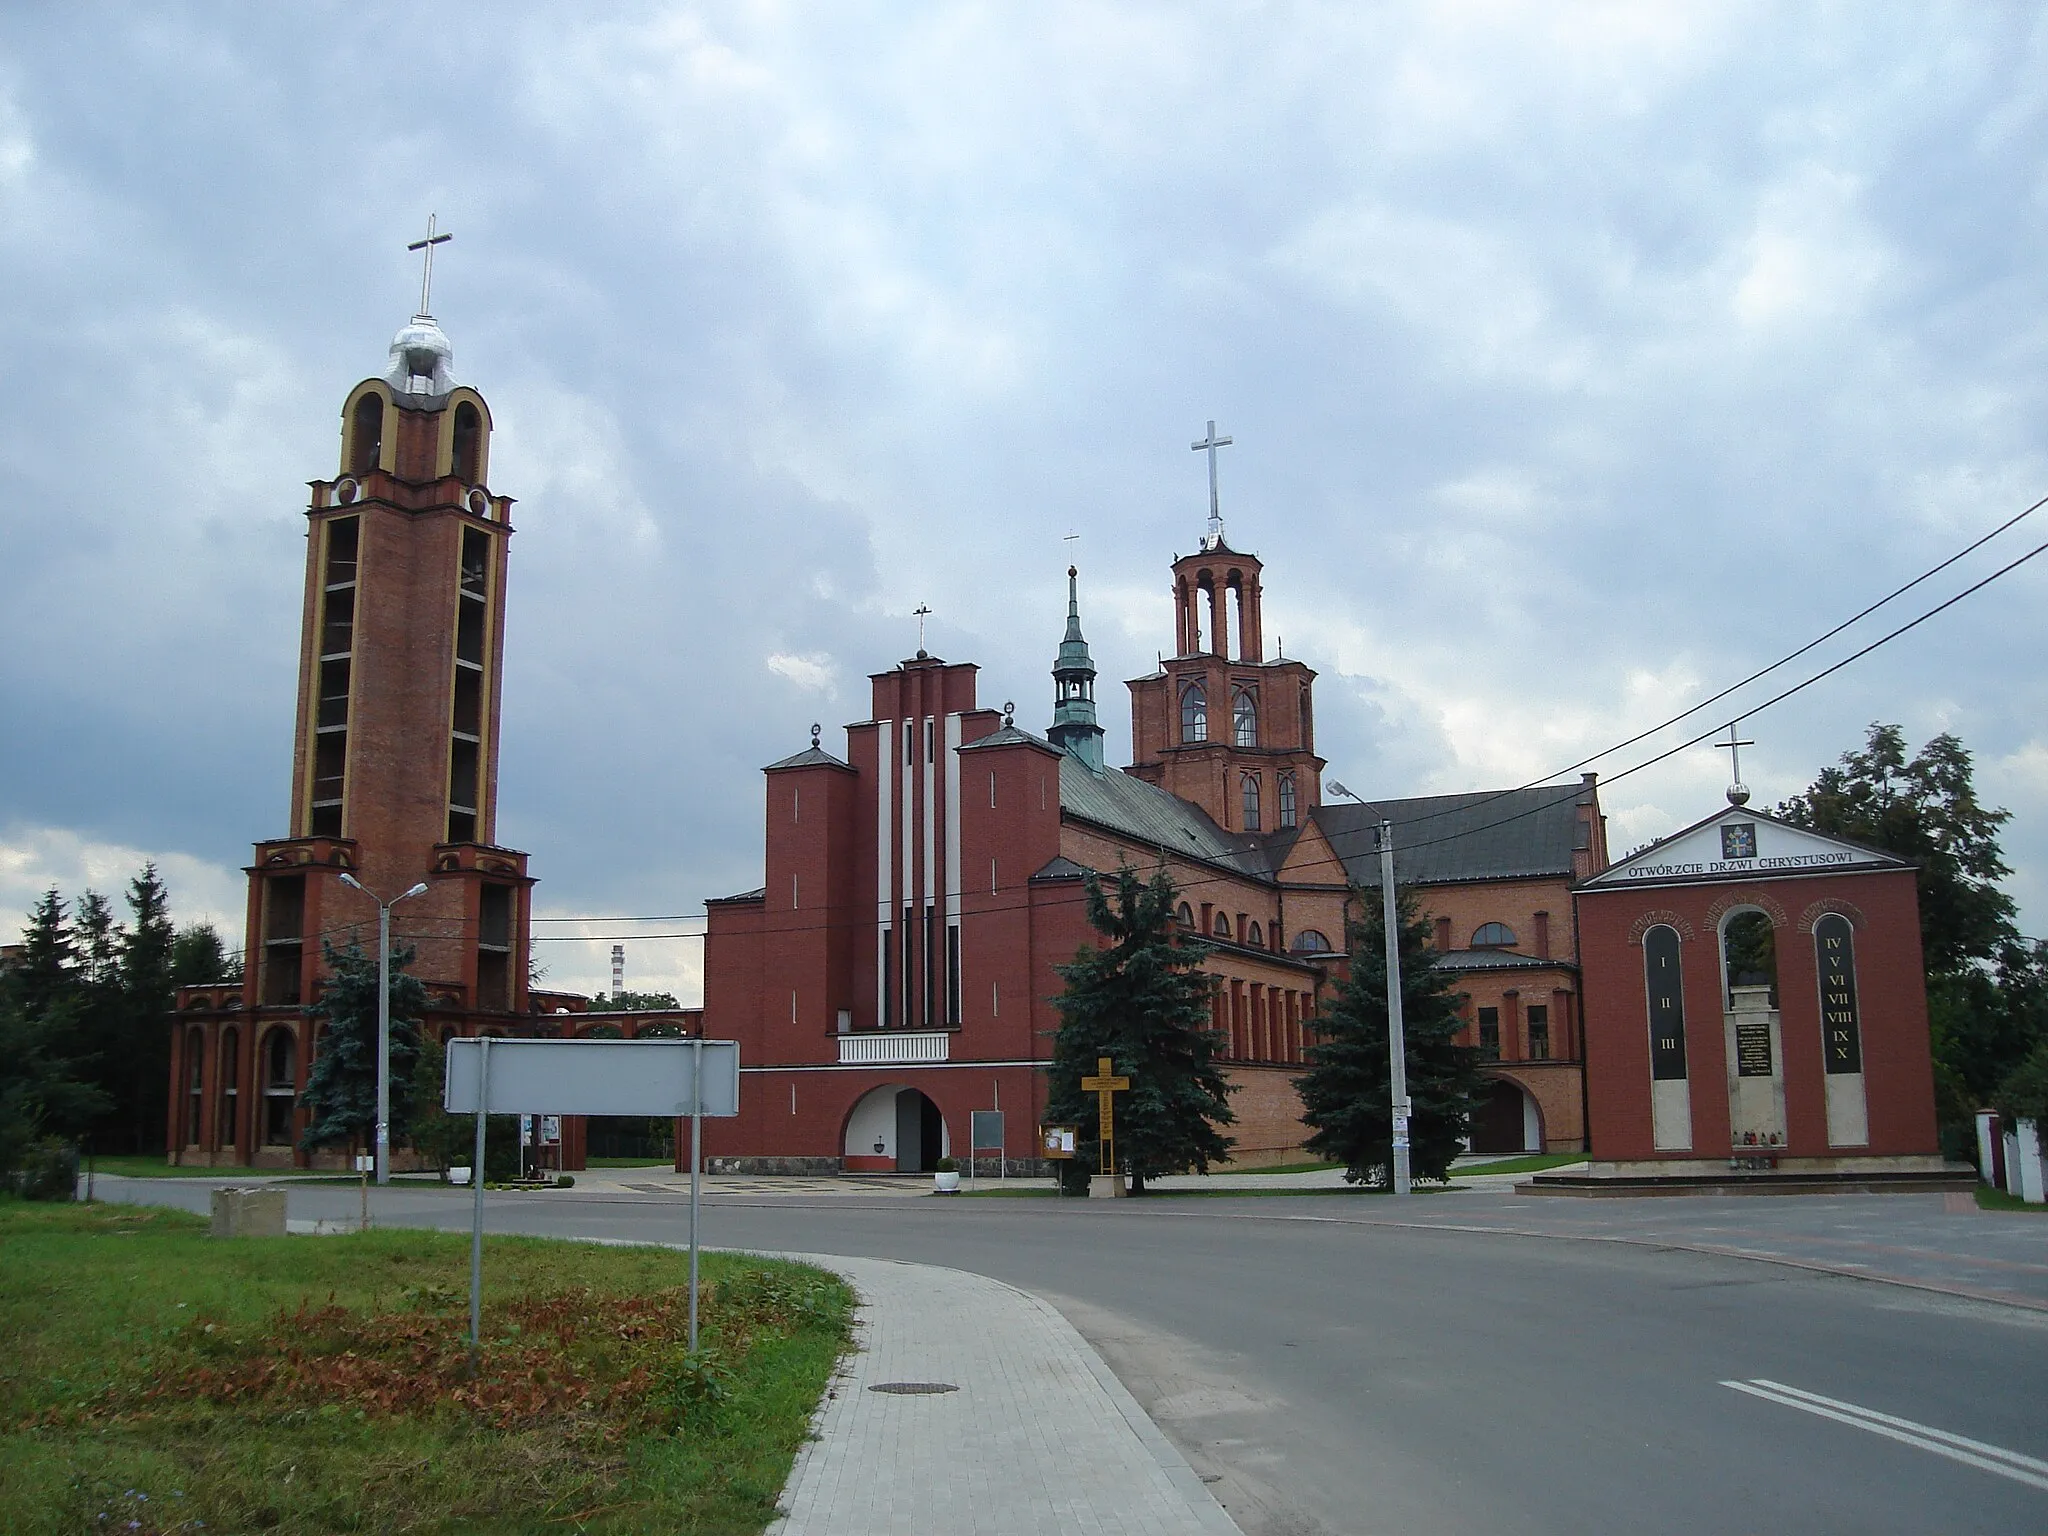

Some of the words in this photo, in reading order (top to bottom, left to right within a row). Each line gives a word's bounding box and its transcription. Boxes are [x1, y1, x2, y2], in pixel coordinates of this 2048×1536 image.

[1628, 863, 1704, 878] OTWÓRZCIE
[1710, 859, 1753, 872] DRZWI
[1758, 852, 1853, 869] CHRYSTUSOWI
[1826, 937, 1841, 949] IV
[1660, 956, 1666, 968] I
[1829, 956, 1841, 968] V
[1829, 975, 1845, 986] VI
[1661, 997, 1671, 1009] II
[1828, 993, 1849, 1005] VII
[1827, 1011, 1852, 1023] VIII
[1833, 1030, 1849, 1042] IX
[1661, 1038, 1675, 1050] III
[1836, 1047, 1848, 1059] X
